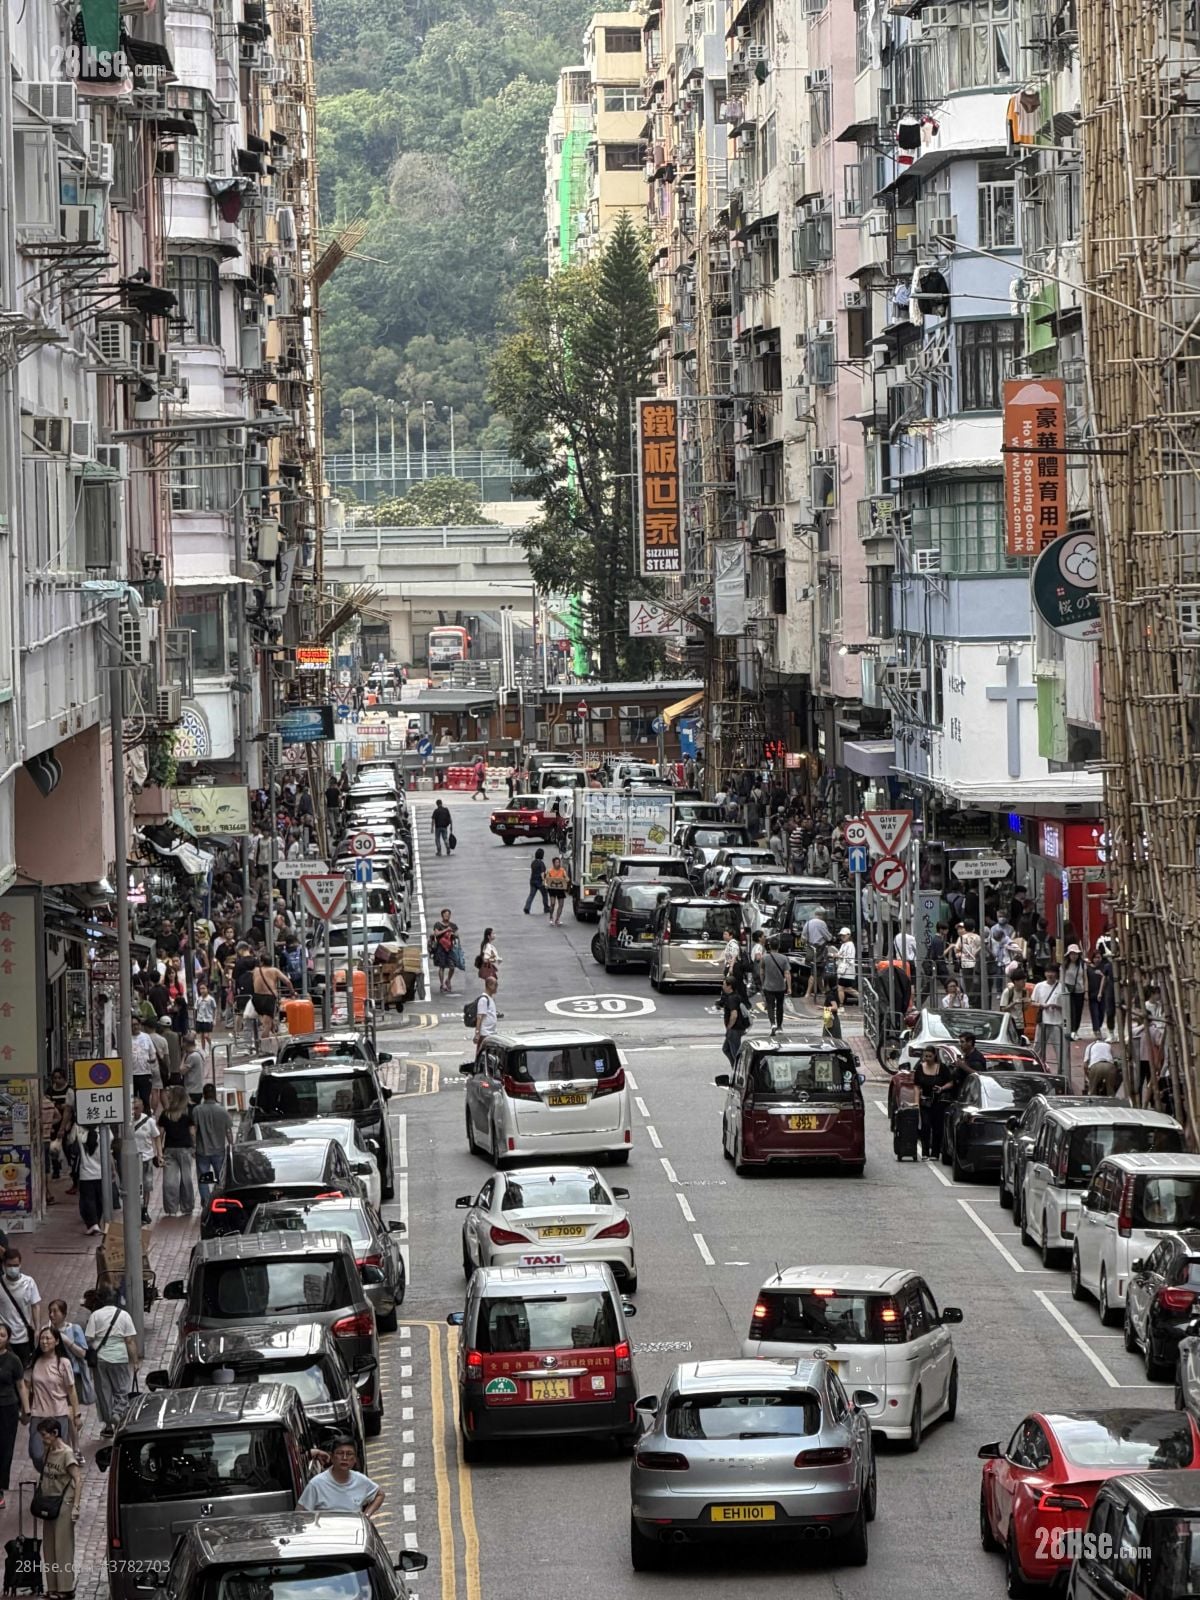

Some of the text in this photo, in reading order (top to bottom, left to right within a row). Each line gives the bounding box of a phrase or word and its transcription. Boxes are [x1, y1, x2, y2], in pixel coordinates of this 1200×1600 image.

[1022, 420, 1033, 436] Ho
[643, 405, 679, 545] 鐵板世家
[1036, 407, 1059, 550] 豪華體育用品
[1023, 459, 1035, 512] Sporting
[1025, 514, 1036, 551] Goods
[646, 548, 679, 558] SIZZLING
[646, 558, 679, 571] STEAK
[1059, 597, 1099, 616] 桜の
[848, 828, 865, 838] 30
[355, 839, 371, 850] 30
[571, 999, 627, 1012] 30
[90, 1092, 113, 1103] End
[86, 1106, 118, 1120] 終止
[542, 1227, 582, 1237] XF 7009
[523, 1255, 561, 1265] TAXI
[535, 1389, 567, 1399] 7833
[723, 1507, 764, 1519] EH 1101
